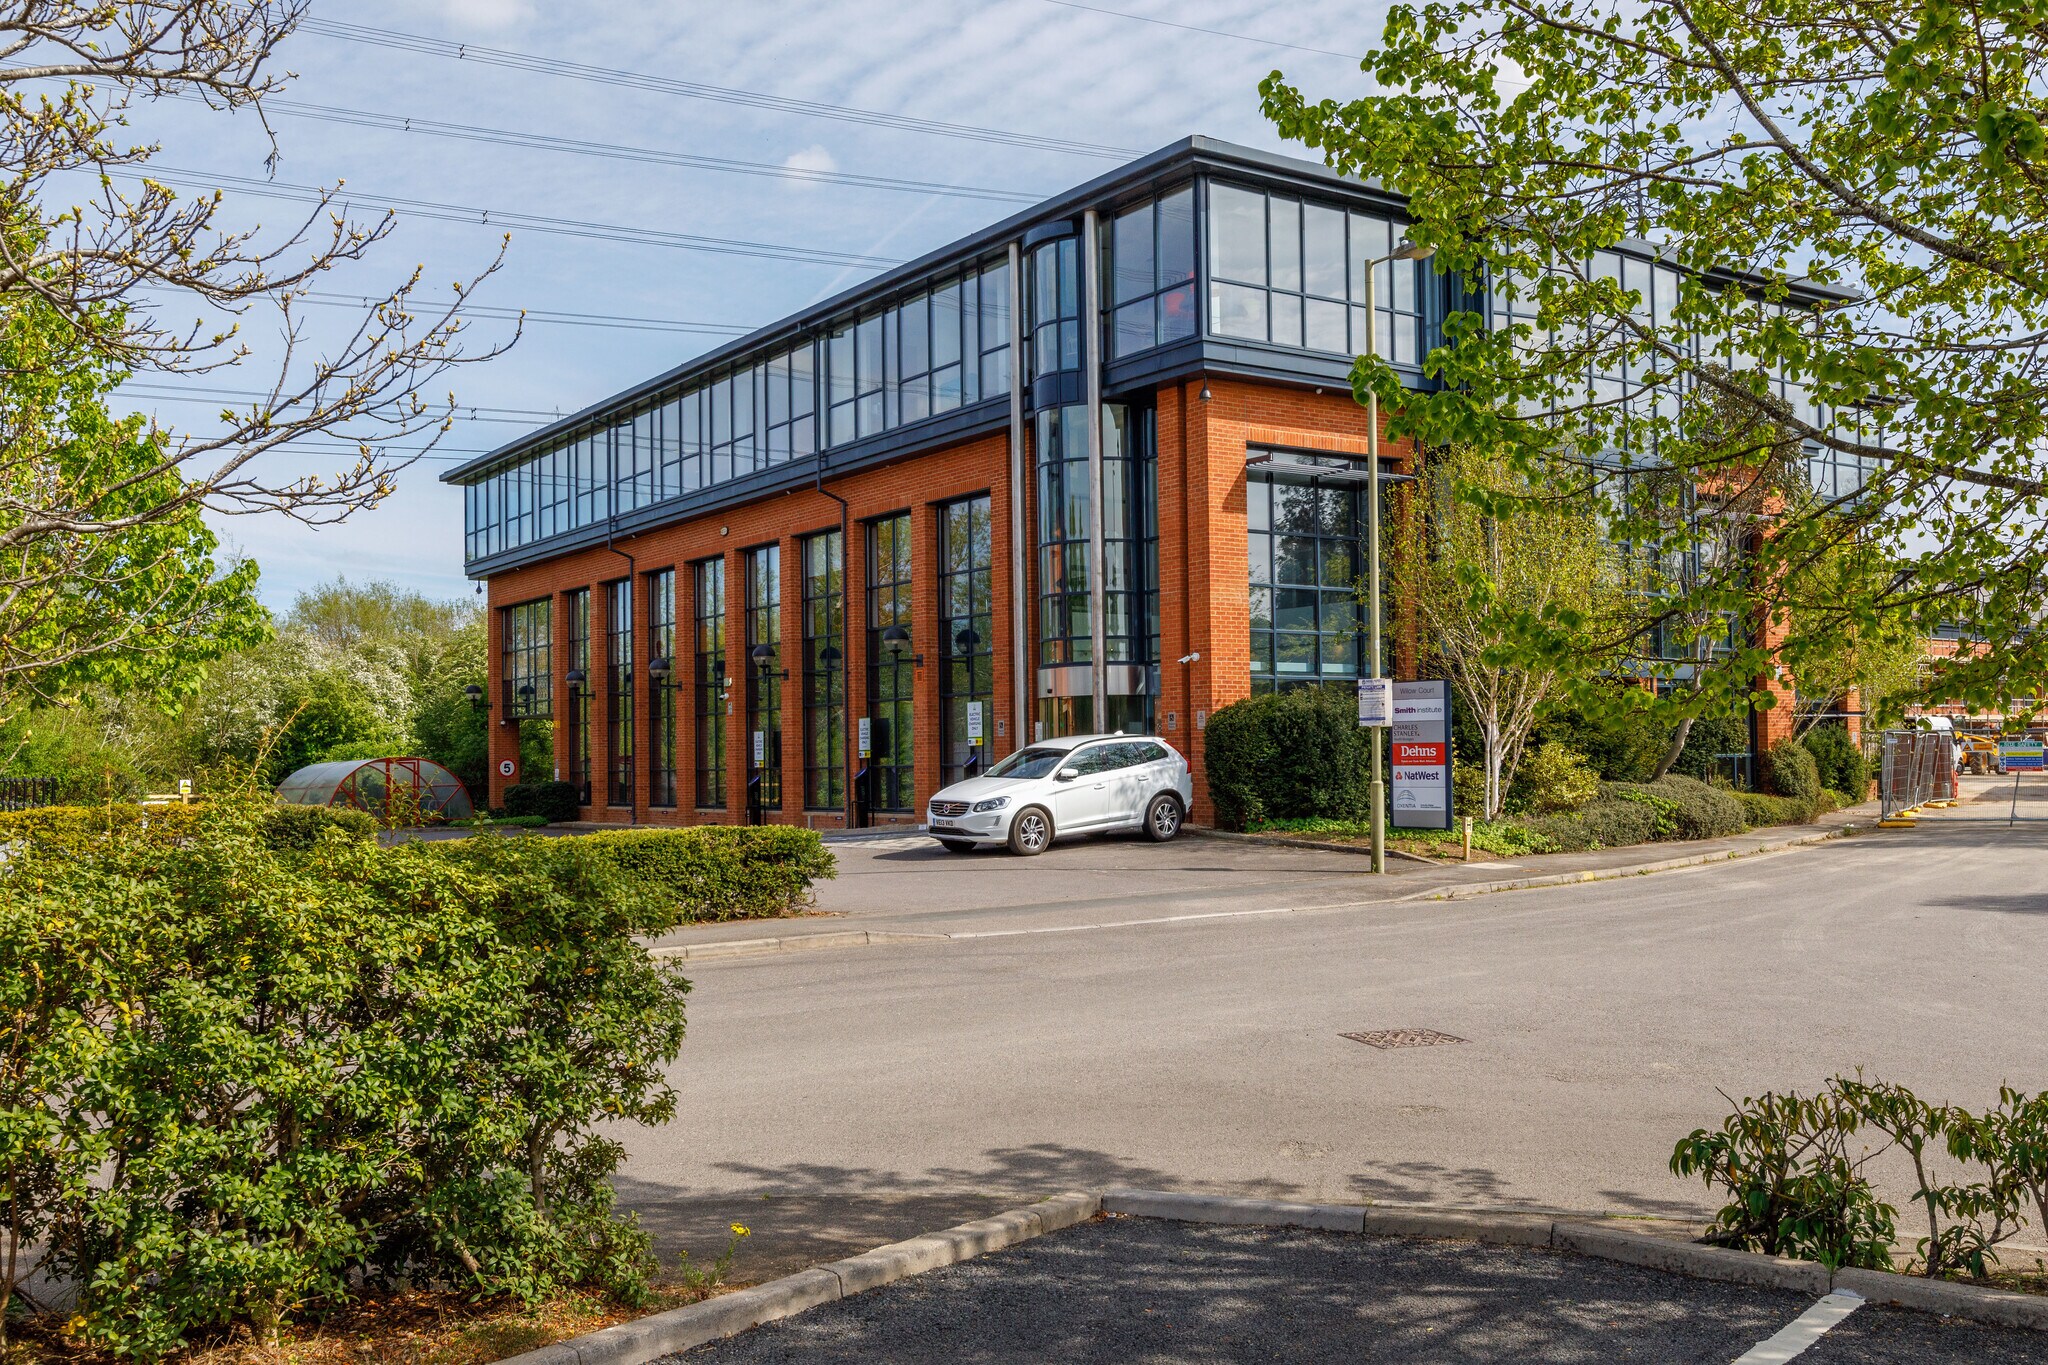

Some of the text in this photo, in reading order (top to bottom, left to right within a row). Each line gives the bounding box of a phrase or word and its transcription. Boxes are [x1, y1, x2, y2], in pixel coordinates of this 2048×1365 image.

[1418, 686, 1435, 694] Court
[1401, 745, 1437, 757] Dehns
[504, 763, 511, 773] 5
[1404, 771, 1439, 780] NatWest
